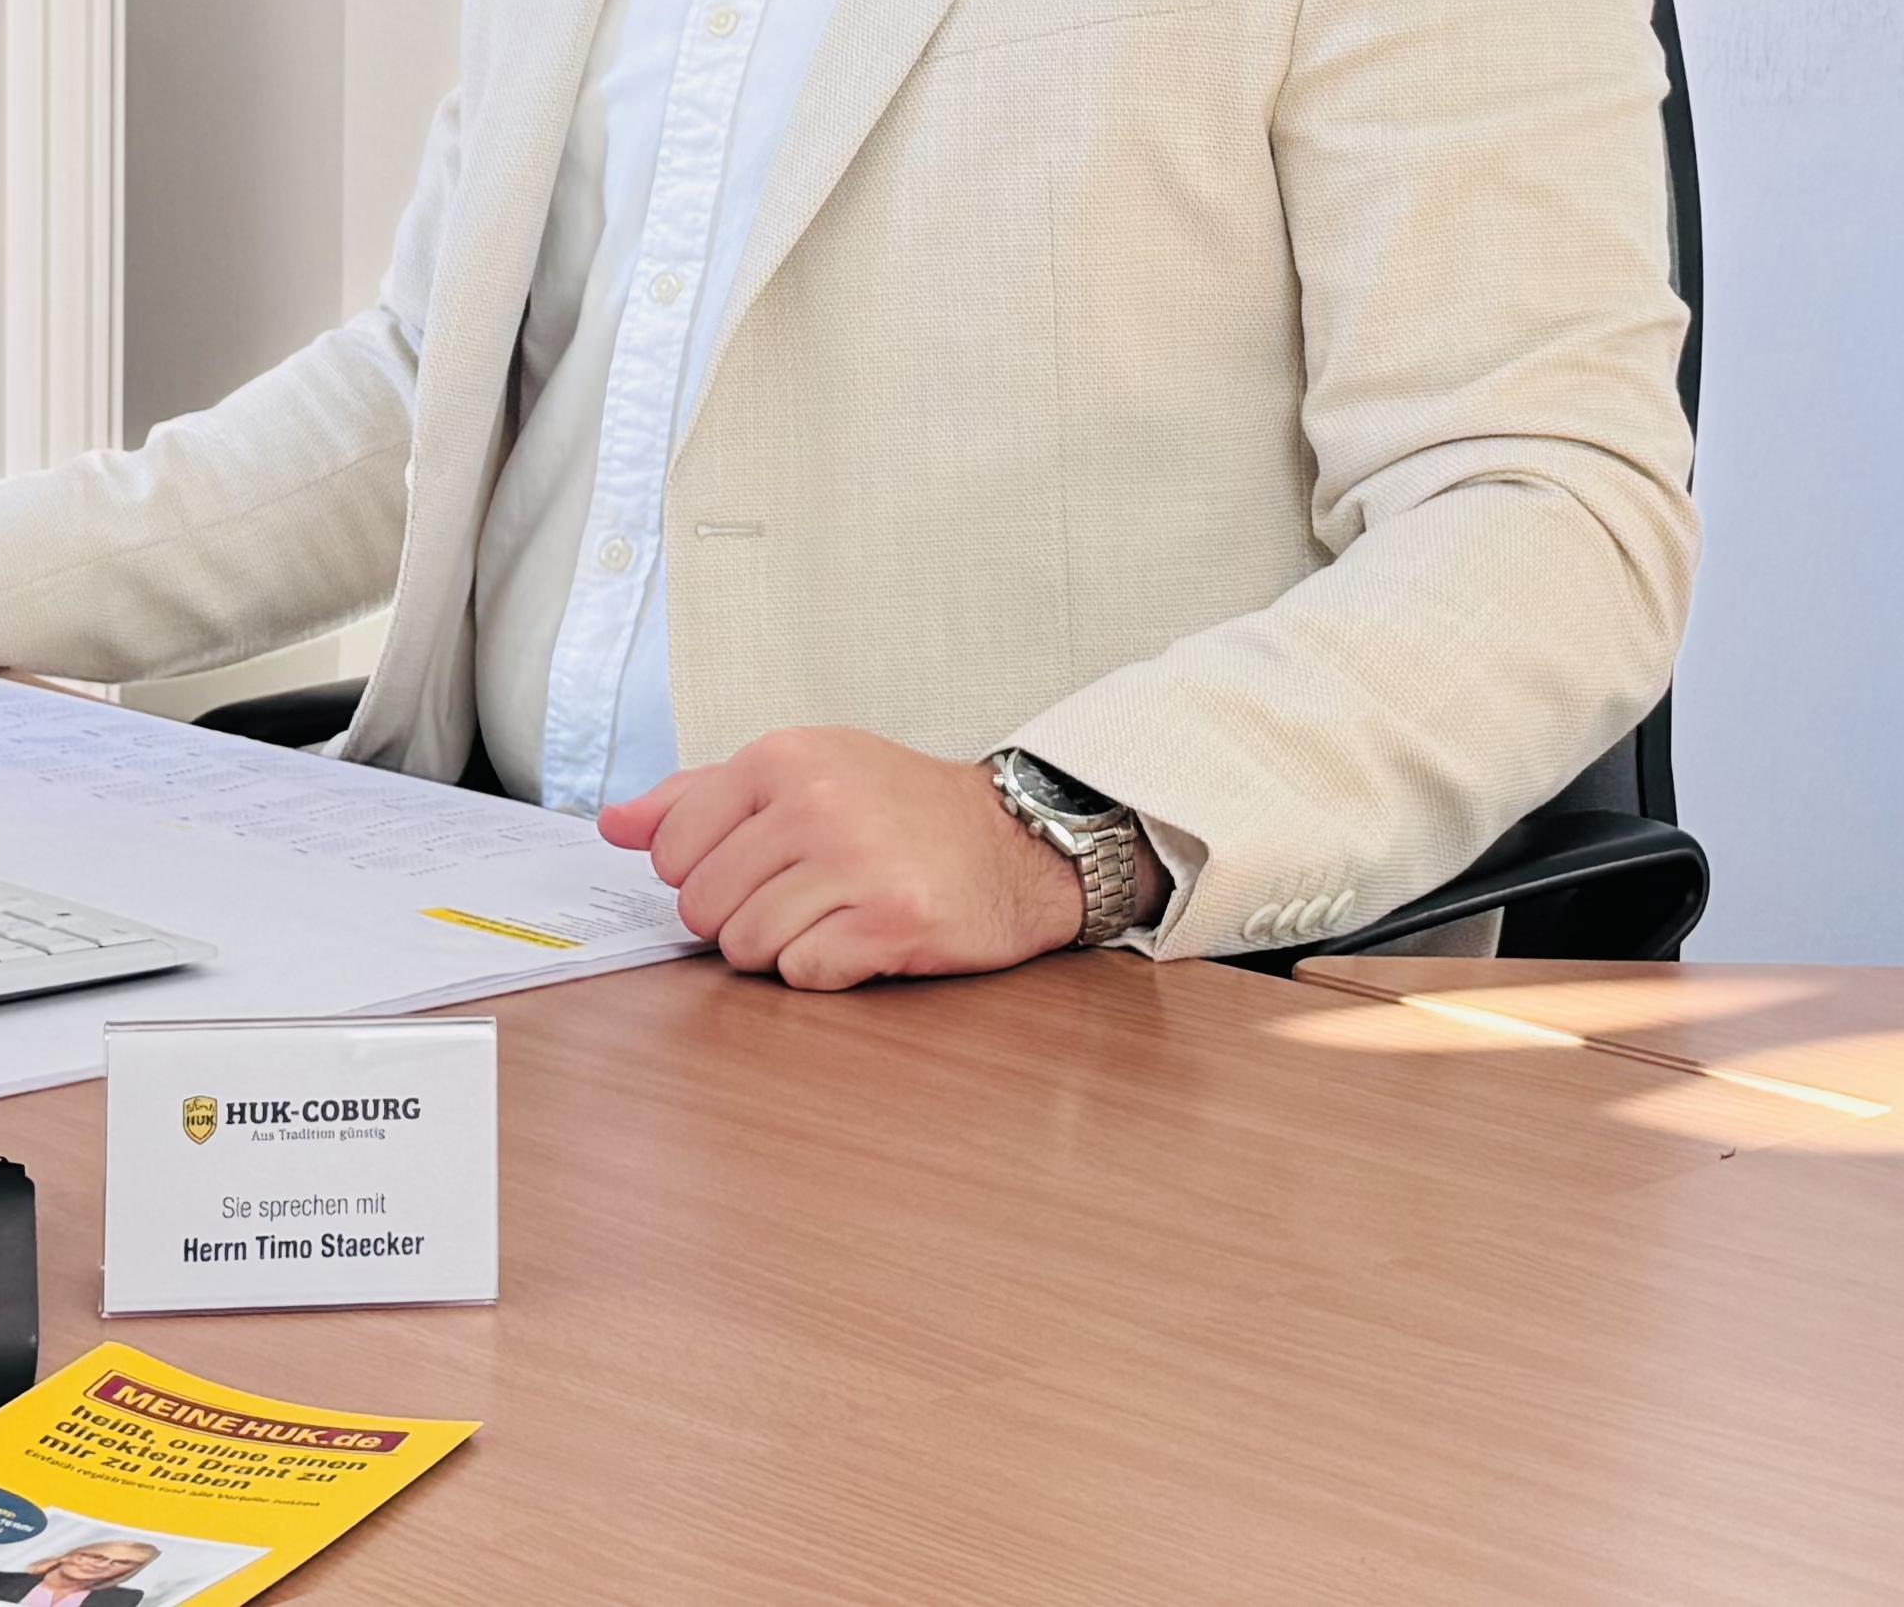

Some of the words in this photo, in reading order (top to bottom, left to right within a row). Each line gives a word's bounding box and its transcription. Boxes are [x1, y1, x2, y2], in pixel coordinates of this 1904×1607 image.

[226, 1098, 421, 1124] HUK-COBURG
[251, 1129, 275, 1141] Aus
[279, 1128, 335, 1141] Tradition
[339, 1127, 386, 1141] günstig
[222, 1196, 252, 1219] Sie
[258, 1194, 349, 1222] sprechen
[356, 1192, 387, 1215] mit
[183, 1236, 247, 1263] Herrn
[255, 1234, 313, 1261] Timo
[320, 1231, 425, 1258] Staecker
[71, 1405, 156, 1444] heißt,
[168, 1438, 268, 1462] online
[278, 1454, 368, 1471] einen
[112, 1385, 384, 1450] MEINEHUK.de
[38, 1434, 96, 1459] mir
[100, 1456, 142, 1473] zu
[149, 1465, 252, 1490] haben
[55, 1420, 189, 1466] direkten
[197, 1458, 291, 1480] Draht
[297, 1471, 339, 1483] zu
